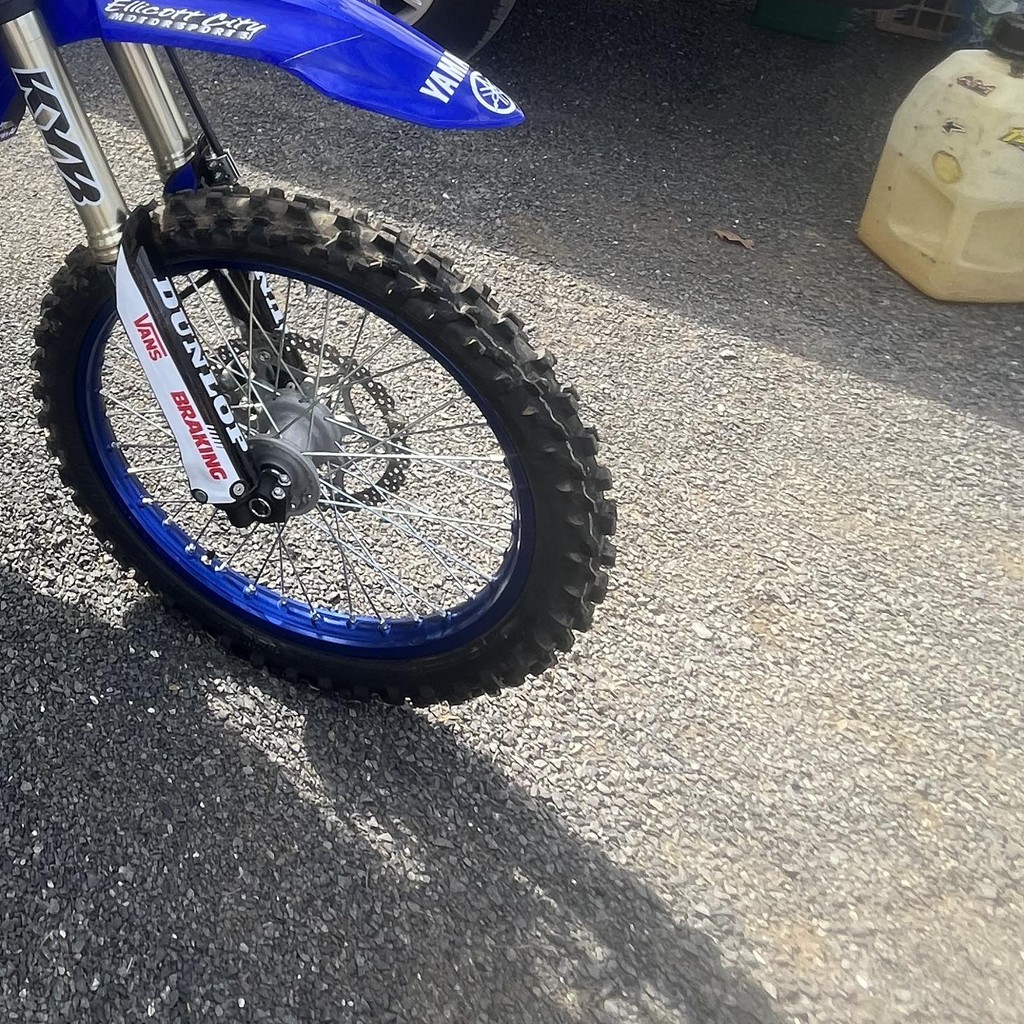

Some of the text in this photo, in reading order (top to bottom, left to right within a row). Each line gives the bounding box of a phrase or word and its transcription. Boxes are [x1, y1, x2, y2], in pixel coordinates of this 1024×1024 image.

[109, 12, 250, 41] MOTORSPORTS
[201, 12, 267, 41] City
[134, 313, 168, 362] VANS
[152, 276, 249, 453] DUNLOP
[170, 390, 228, 481] BRAKING
